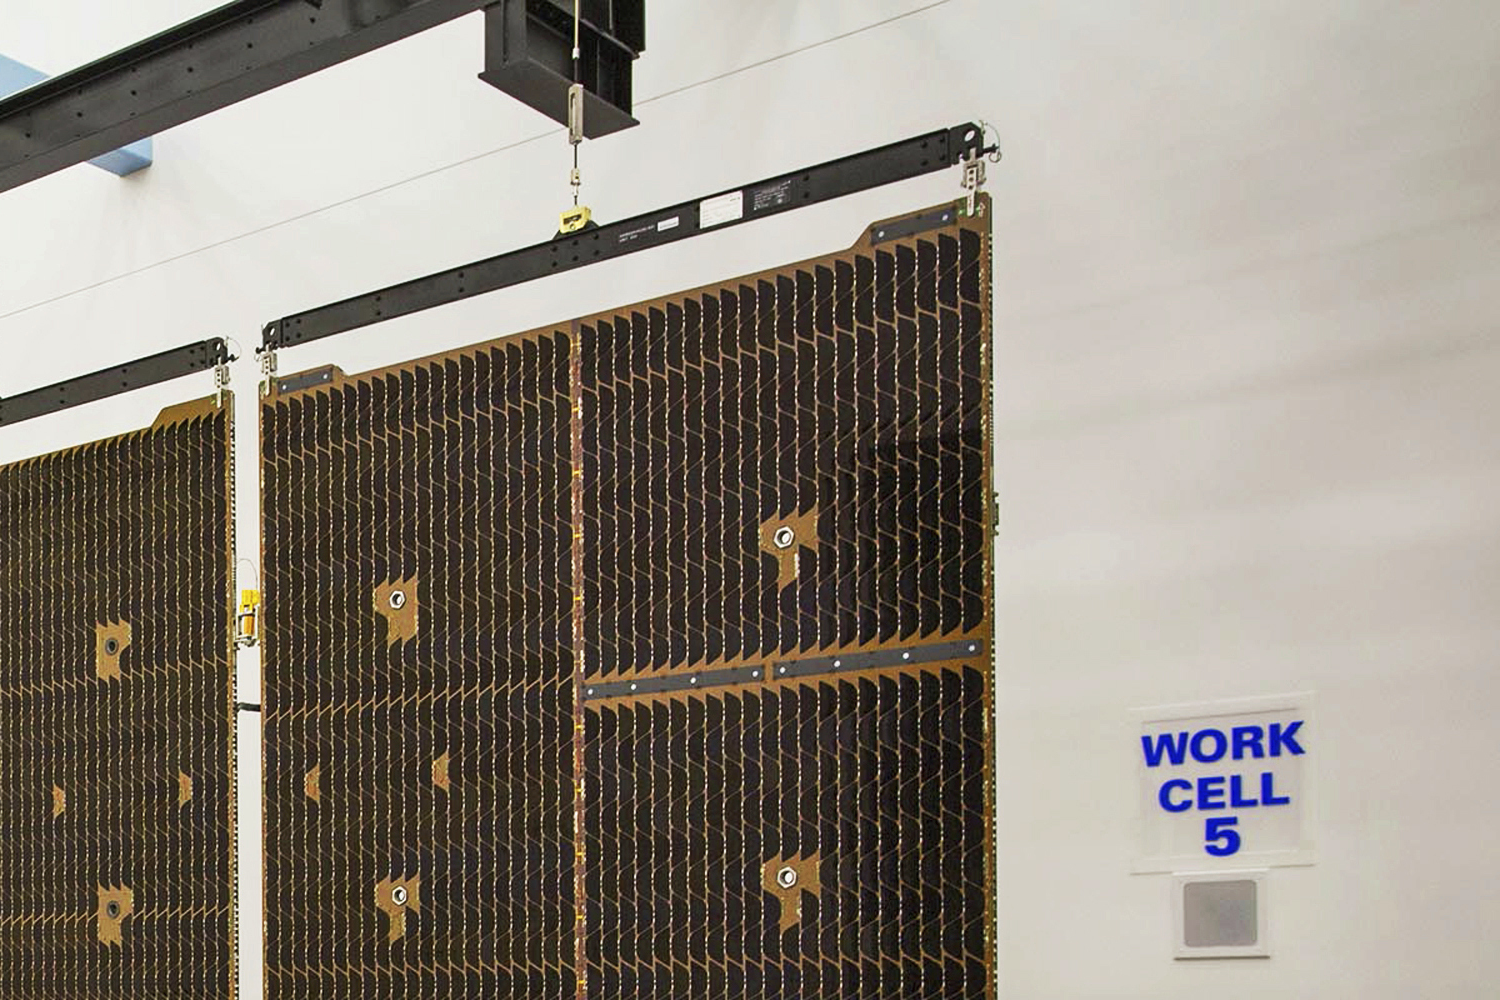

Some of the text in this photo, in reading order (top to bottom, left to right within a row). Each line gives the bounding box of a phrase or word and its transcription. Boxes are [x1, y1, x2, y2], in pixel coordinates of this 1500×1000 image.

[1140, 720, 1306, 768] WORK
[1158, 771, 1291, 813] CELL
[1204, 816, 1242, 857] 5
